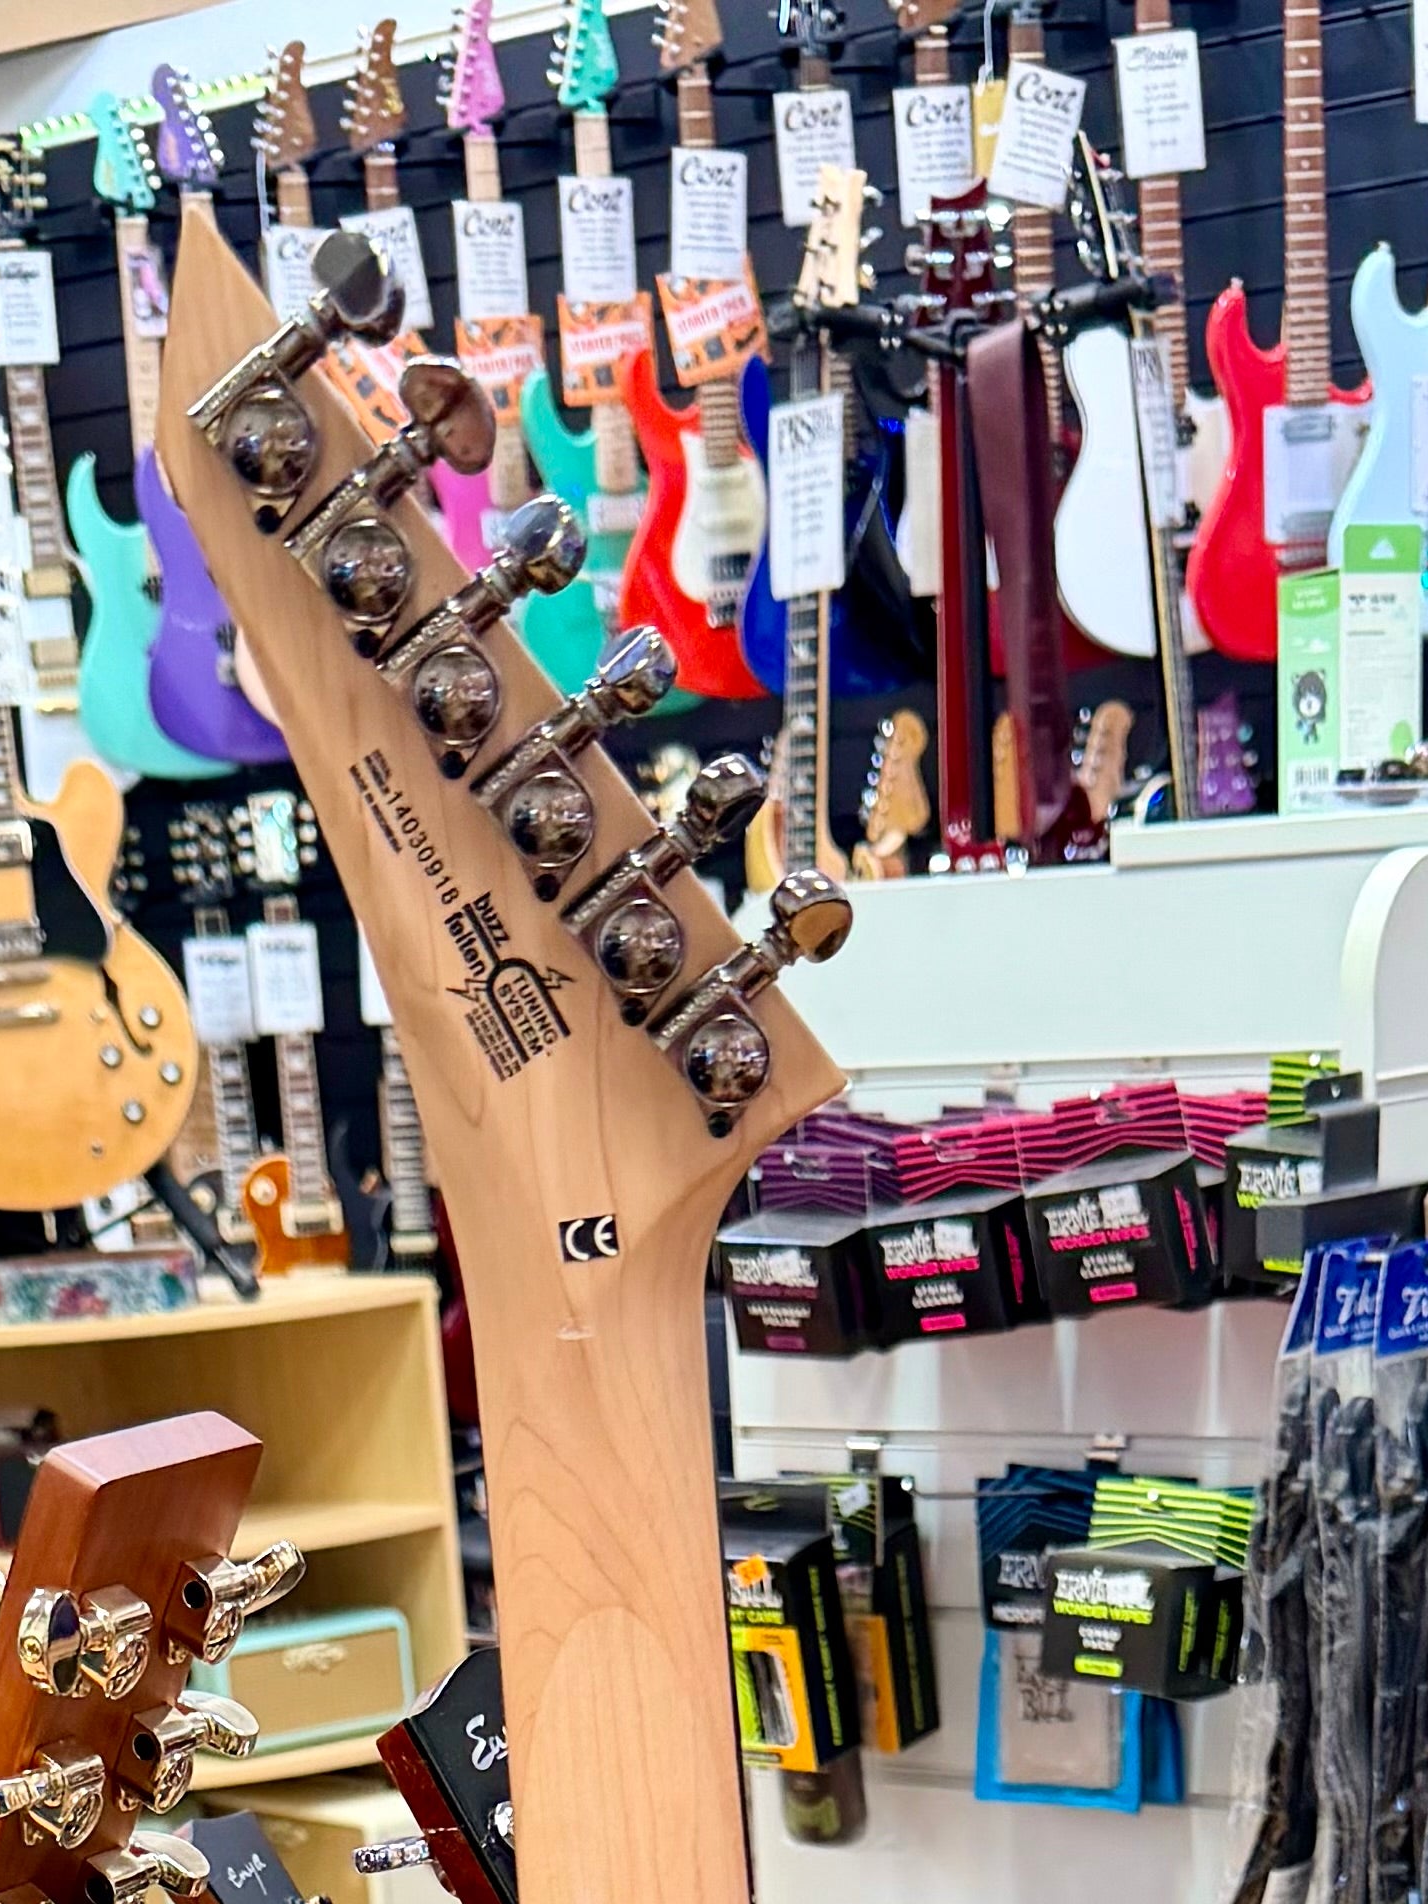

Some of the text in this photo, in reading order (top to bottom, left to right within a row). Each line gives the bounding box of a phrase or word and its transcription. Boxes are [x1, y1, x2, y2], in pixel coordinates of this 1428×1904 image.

[783, 100, 844, 134] Cort
[905, 96, 966, 130] Cort
[679, 156, 737, 191] Cort
[385, 790, 460, 906] 14030918
[472, 890, 512, 948] buzz
[497, 982, 544, 1056] SYSTEM
[511, 973, 559, 1045] TUNING
[999, 1553, 1045, 1589] ERN
